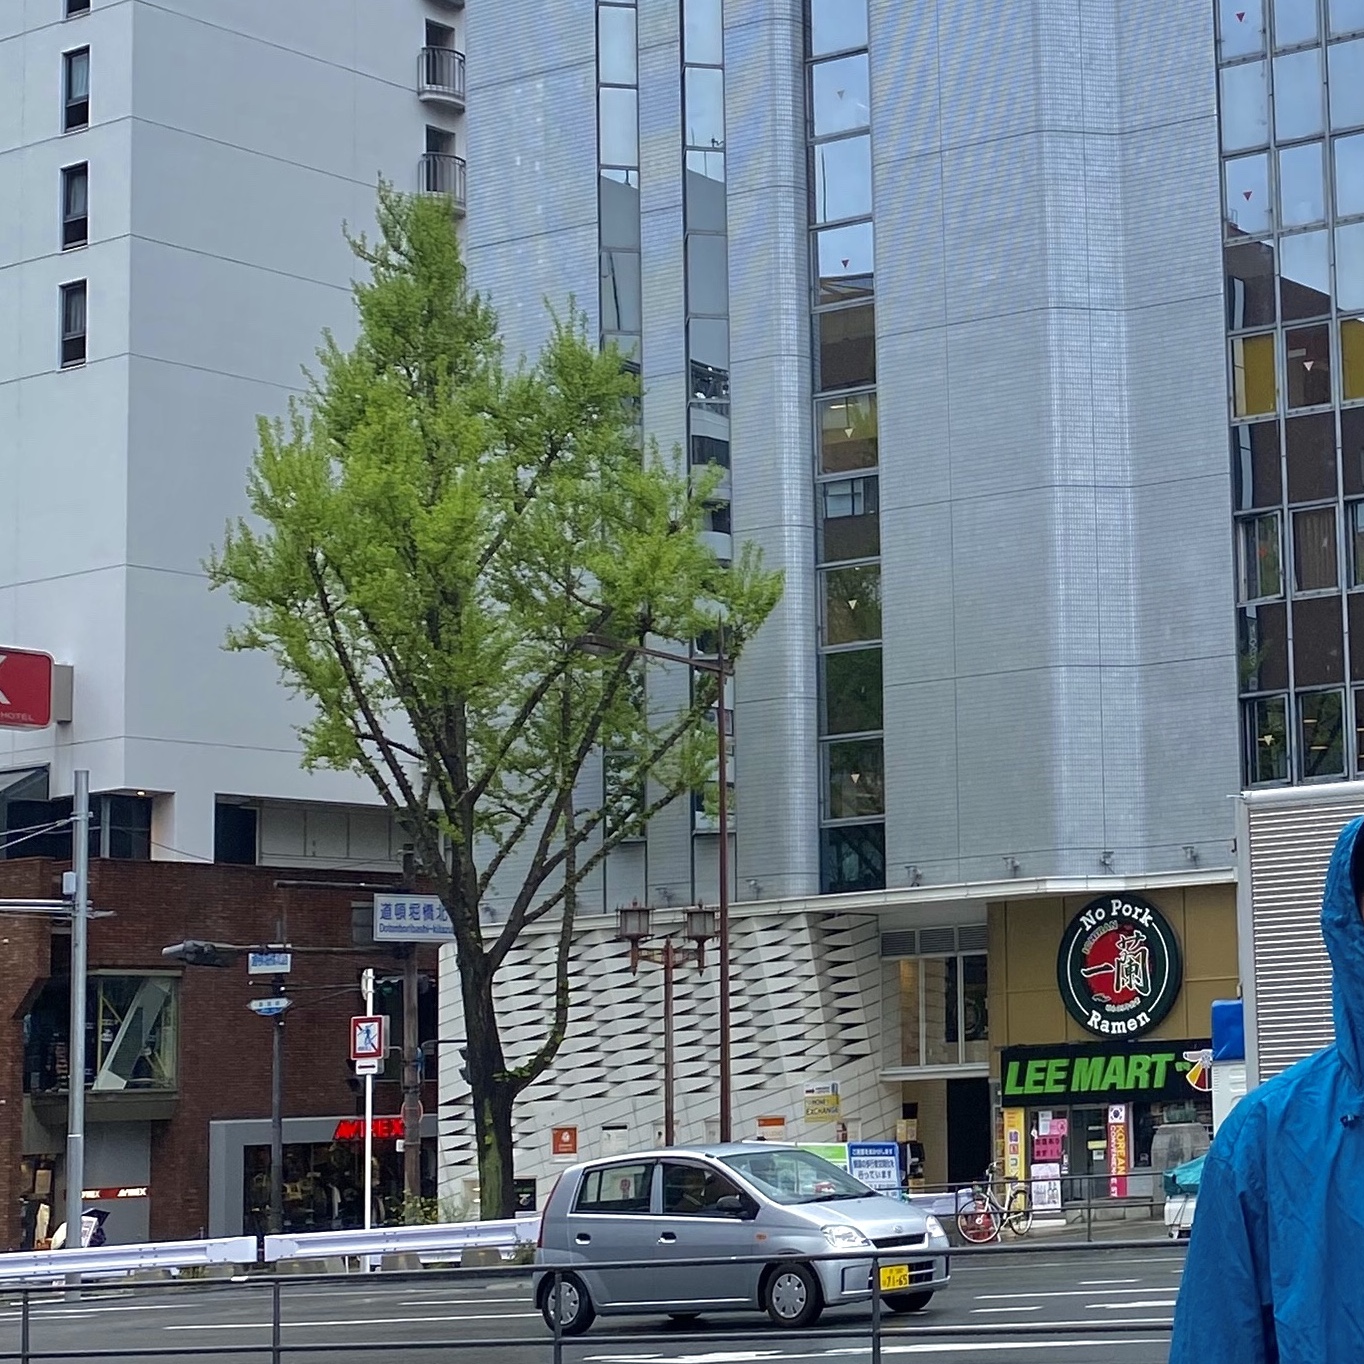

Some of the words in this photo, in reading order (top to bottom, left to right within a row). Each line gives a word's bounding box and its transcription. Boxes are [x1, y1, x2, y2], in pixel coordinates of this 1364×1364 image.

[1080, 908, 1106, 932] No
[1111, 899, 1154, 928] Pork
[1080, 929, 1152, 997] 一蘭
[1086, 1009, 1151, 1035] Ramen
[1004, 1058, 1071, 1096] LEE
[1070, 1052, 1176, 1092] MART
[1116, 1124, 1126, 1176] KOREAN
